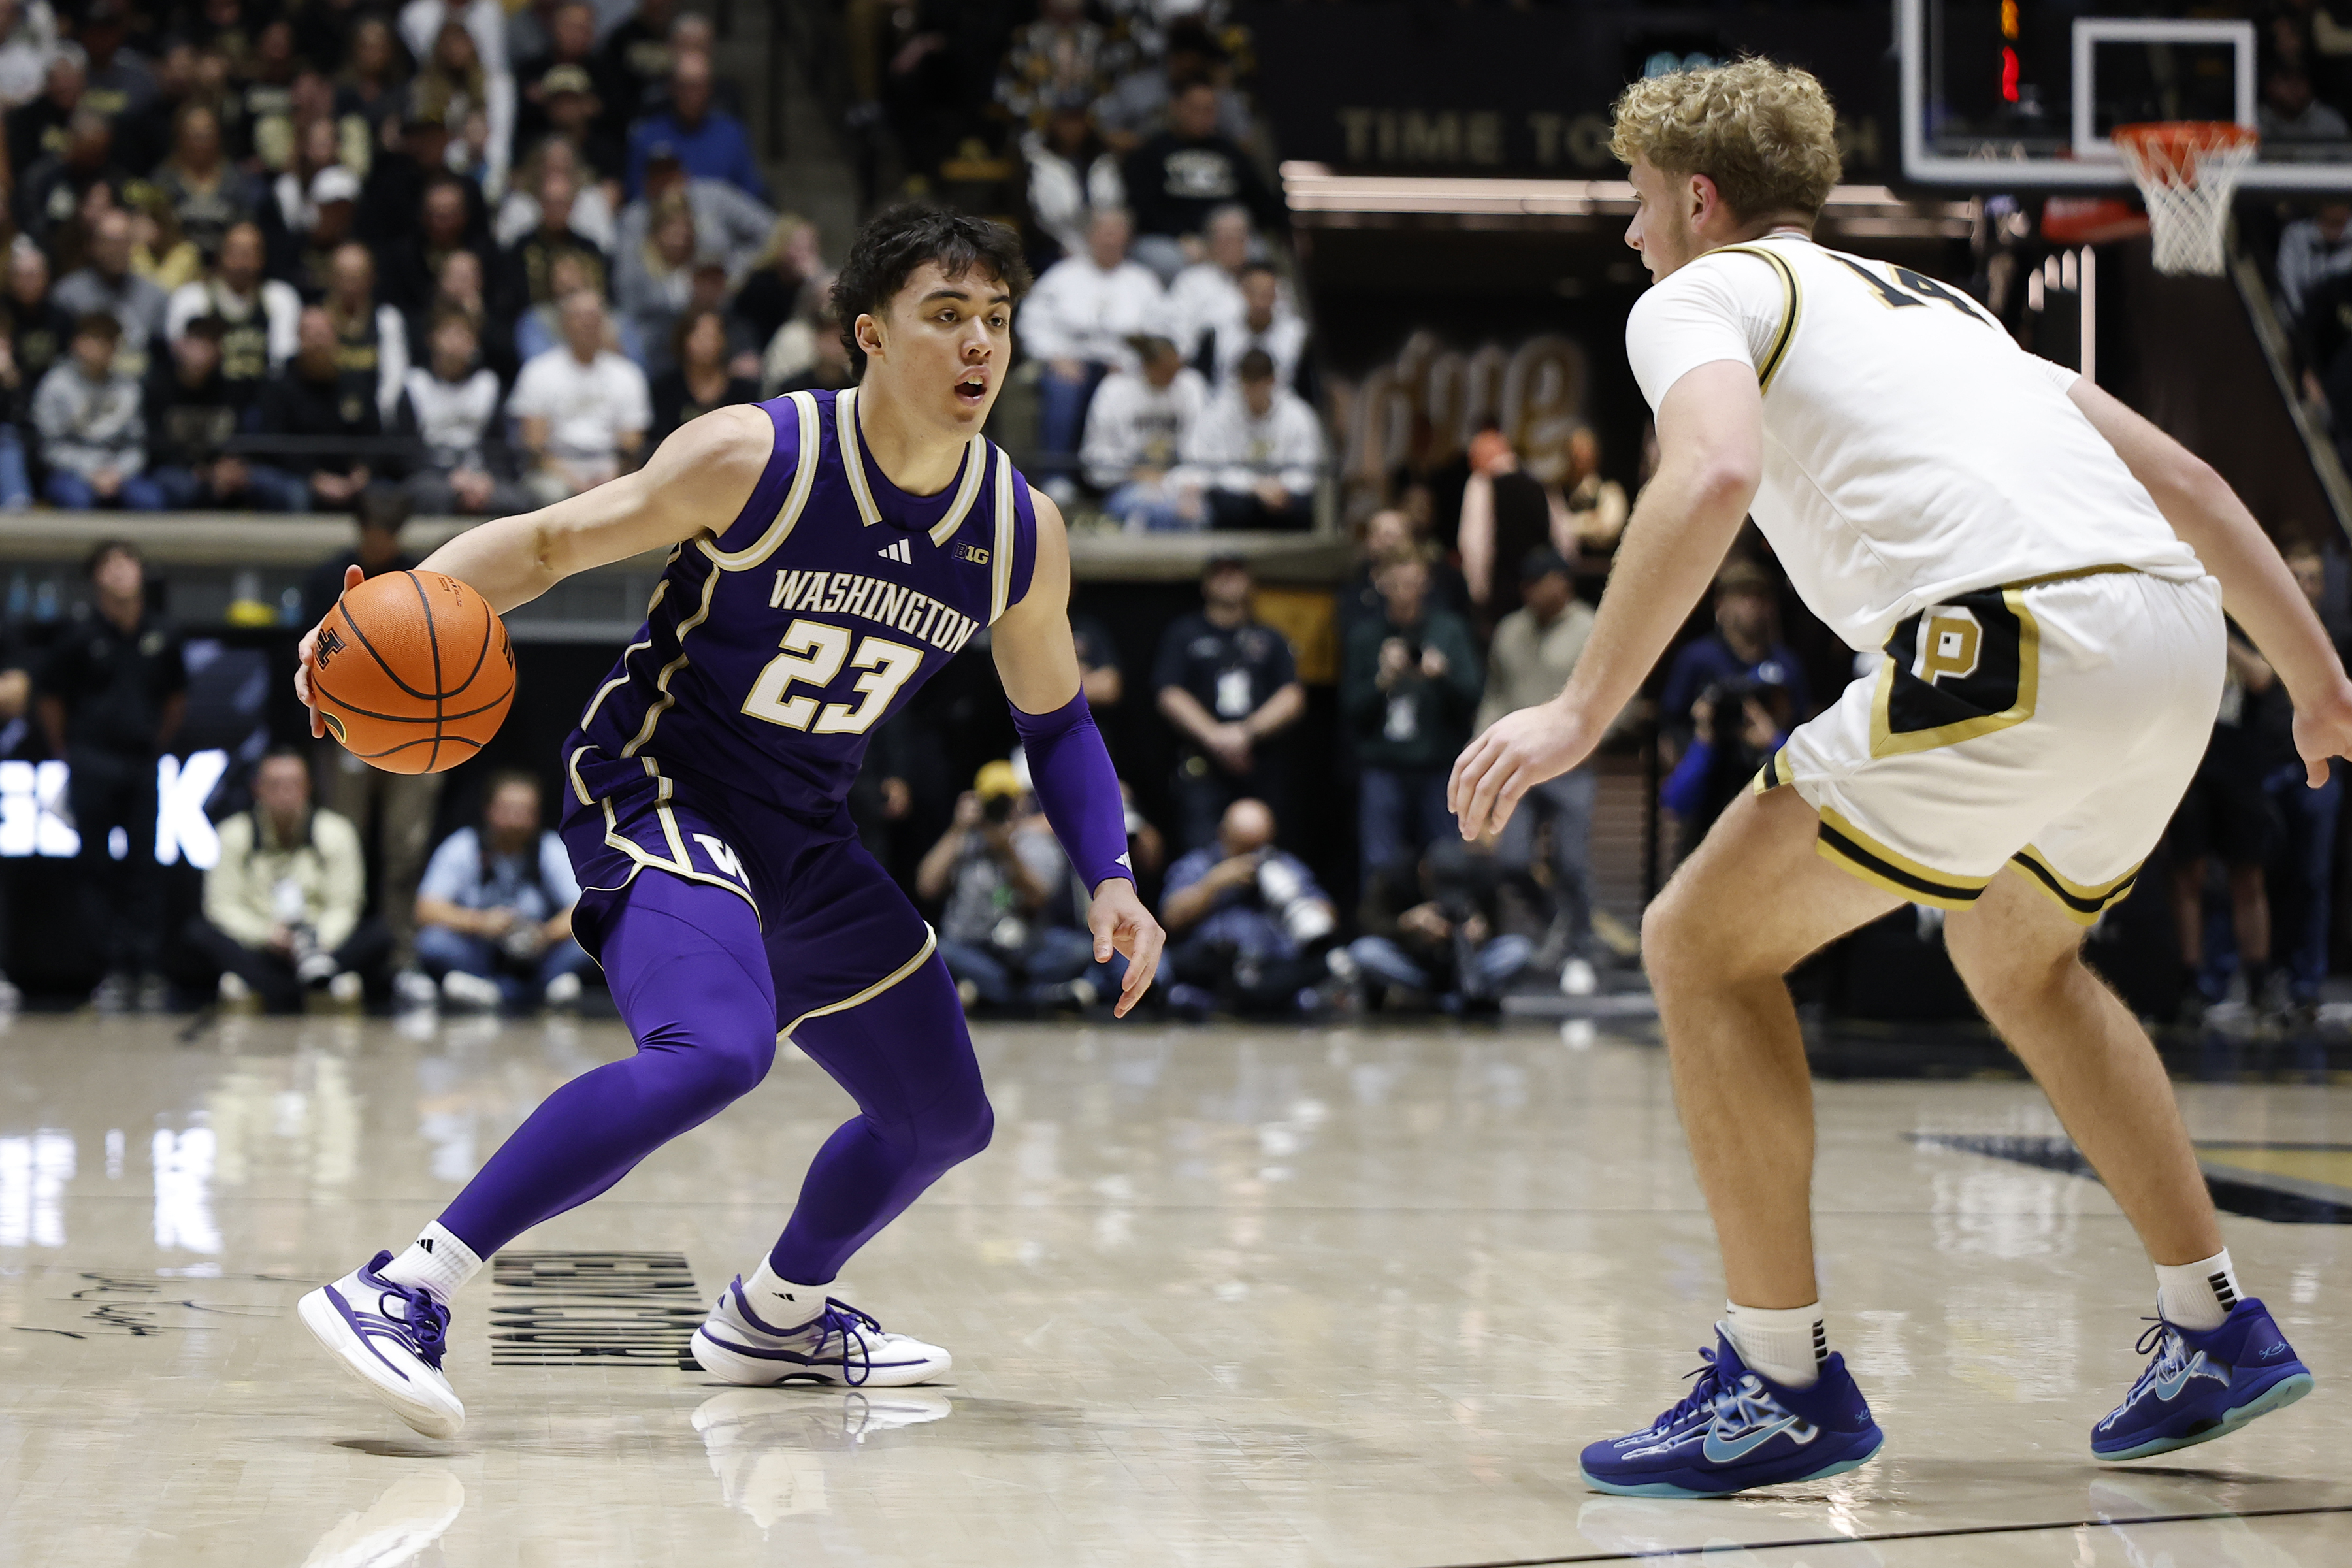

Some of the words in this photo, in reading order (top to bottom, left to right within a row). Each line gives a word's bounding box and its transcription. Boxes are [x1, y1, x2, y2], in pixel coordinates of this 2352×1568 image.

[1335, 106, 1504, 166] TIME
[768, 569, 980, 654] WASHINGTON
[1910, 604, 1983, 687] P
[740, 618, 925, 735] 23
